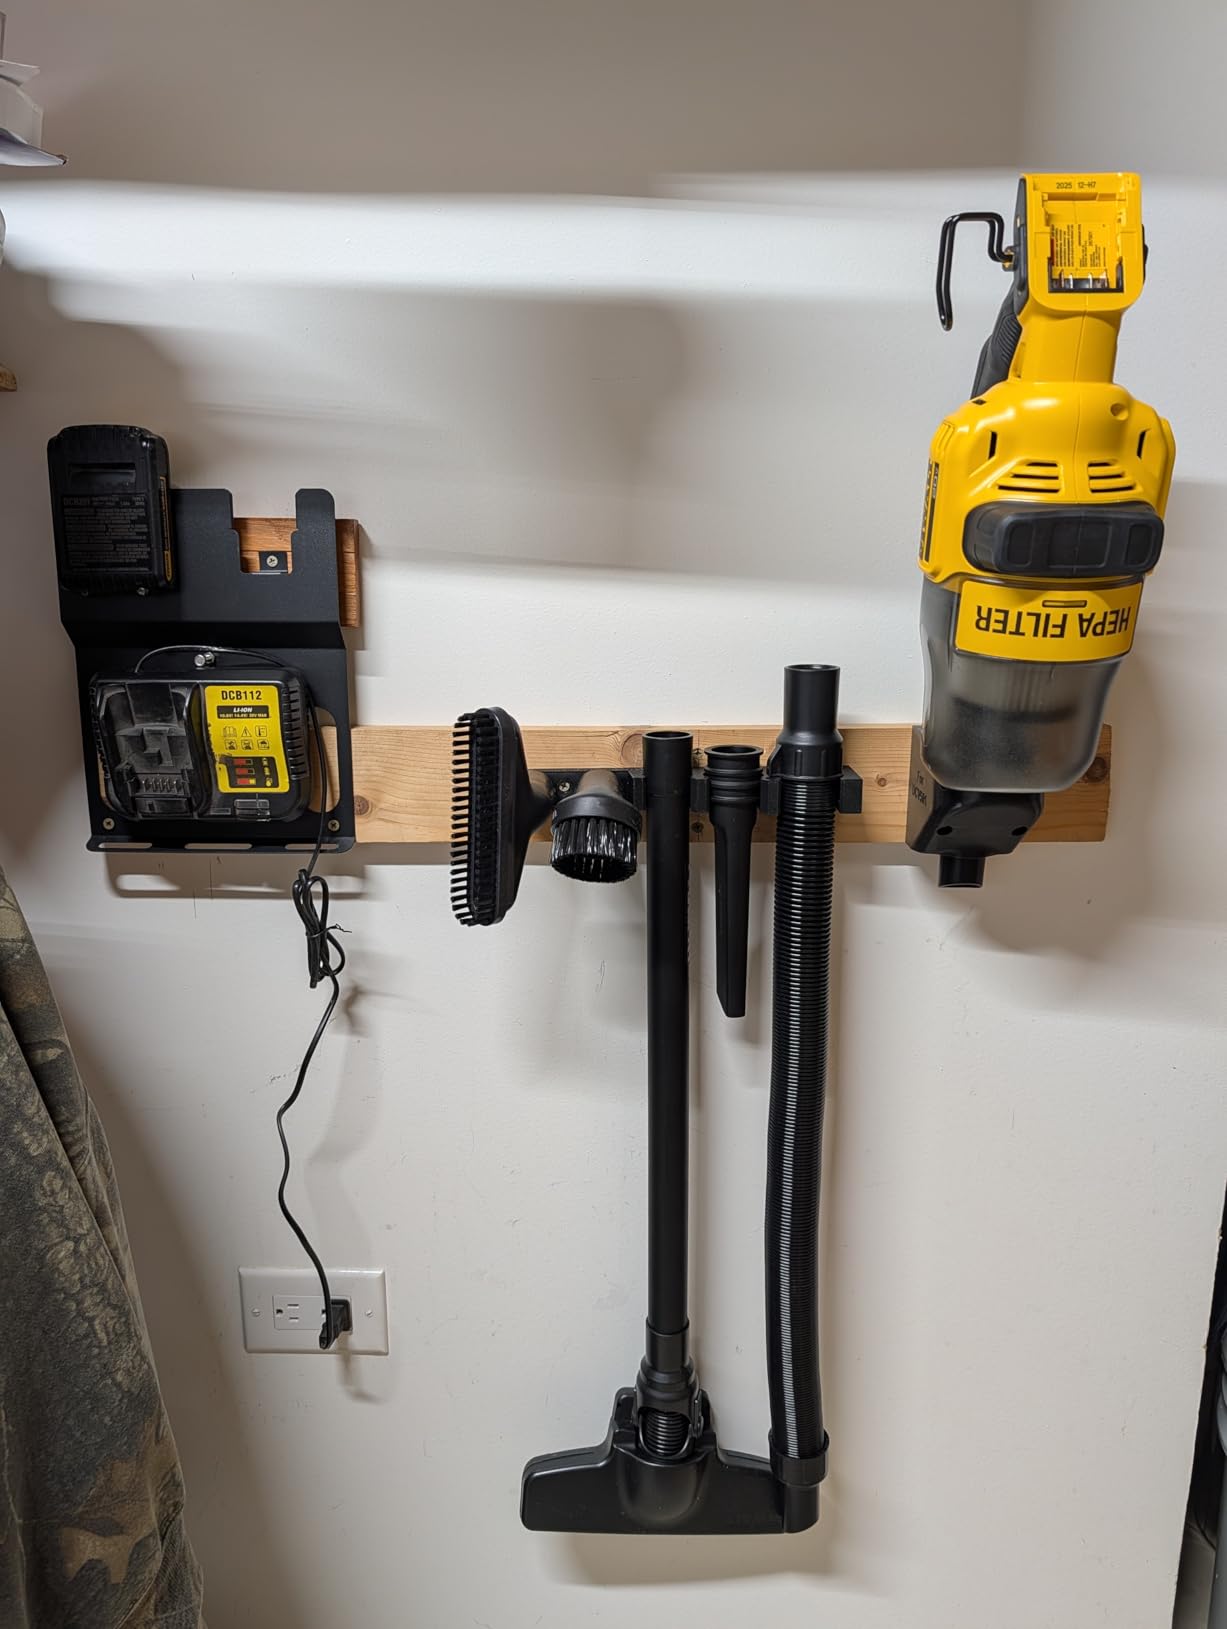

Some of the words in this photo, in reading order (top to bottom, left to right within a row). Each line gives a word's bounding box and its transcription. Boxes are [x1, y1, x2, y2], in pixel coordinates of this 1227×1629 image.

[975, 605, 1068, 638] FILTER
[1077, 606, 1131, 638] HEPA
[221, 690, 262, 700] DCB112
